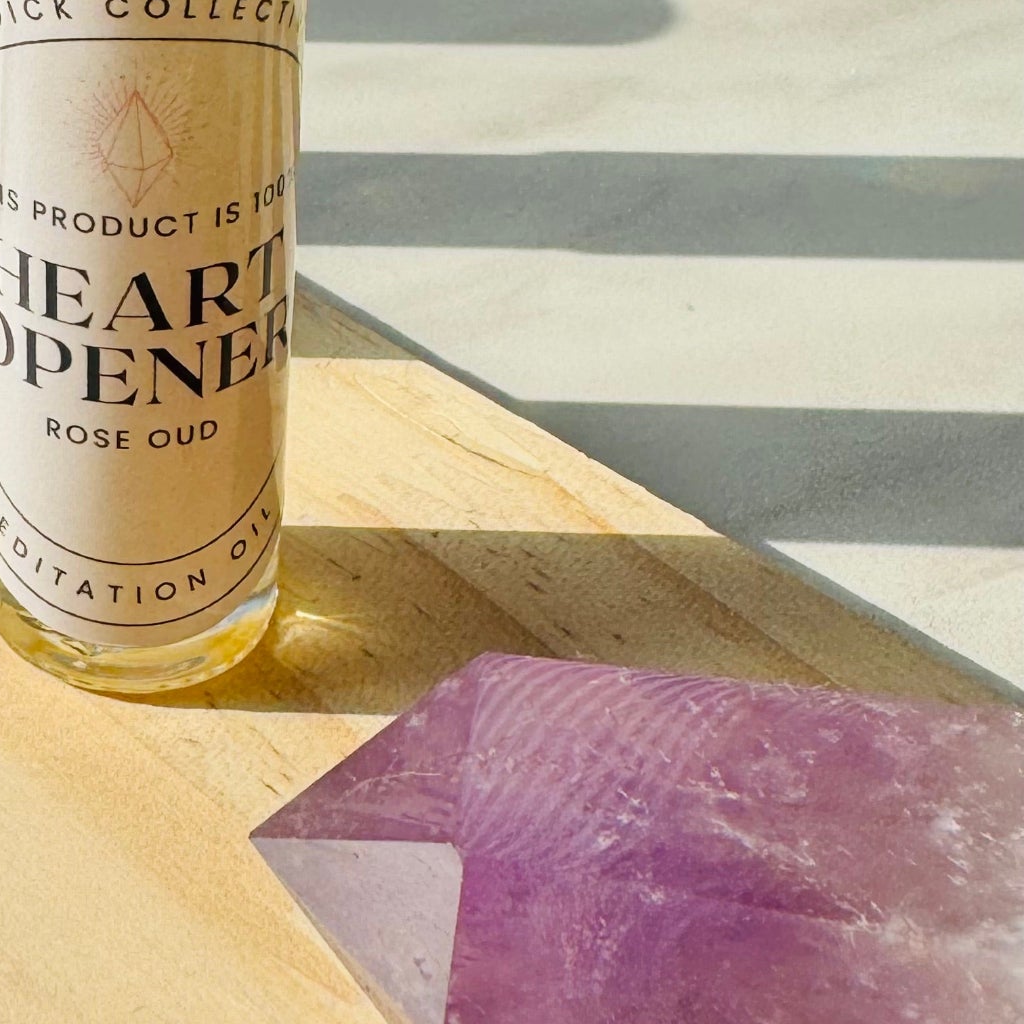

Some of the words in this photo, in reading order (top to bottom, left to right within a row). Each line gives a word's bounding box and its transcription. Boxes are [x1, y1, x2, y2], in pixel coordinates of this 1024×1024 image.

[32, 200, 199, 238] PRODUCT
[214, 202, 241, 228] IS
[46, 417, 131, 449] ROSE
[148, 419, 219, 449] OUD
[230, 507, 272, 561] OIL
